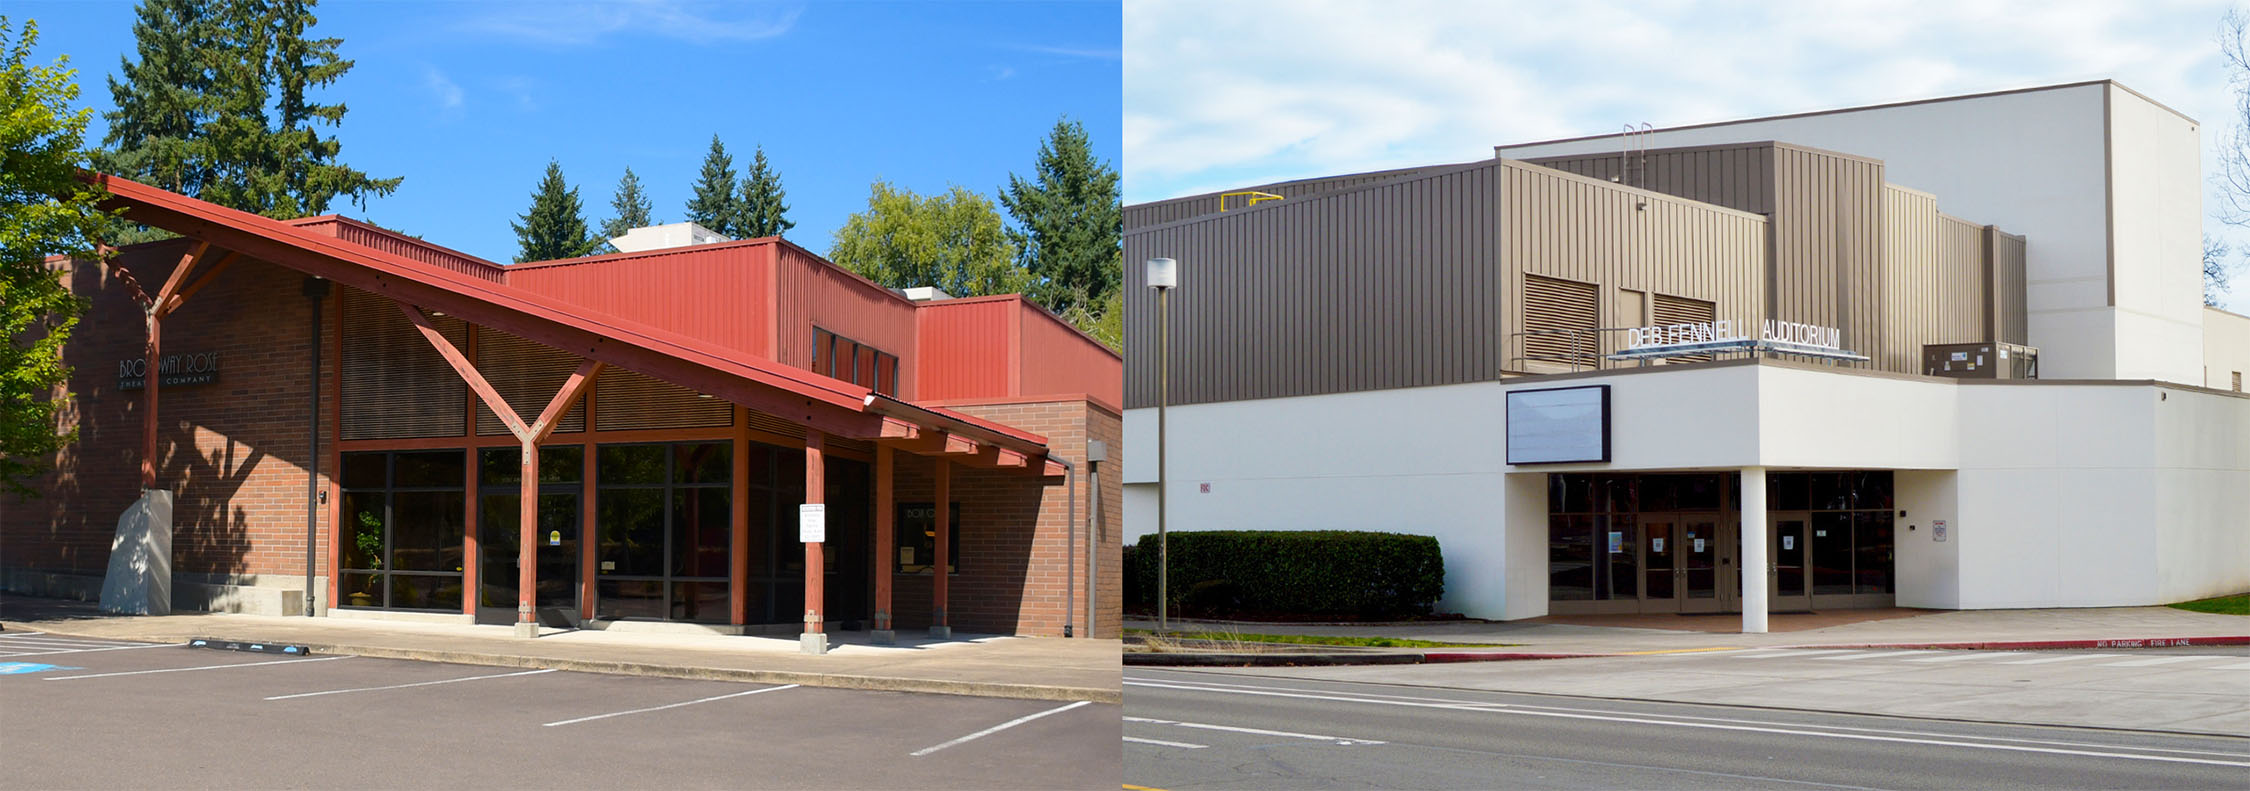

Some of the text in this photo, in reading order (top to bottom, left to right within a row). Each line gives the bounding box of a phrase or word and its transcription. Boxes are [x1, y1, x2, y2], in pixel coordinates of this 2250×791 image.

[1628, 318, 1840, 350] DEB FENNELL AUDITORIUM
[120, 352, 217, 378] BROWAY ROSE
[166, 375, 211, 385] COMPANY
[2111, 640, 2143, 648] PARKING
[2150, 639, 2166, 648] FIRE
